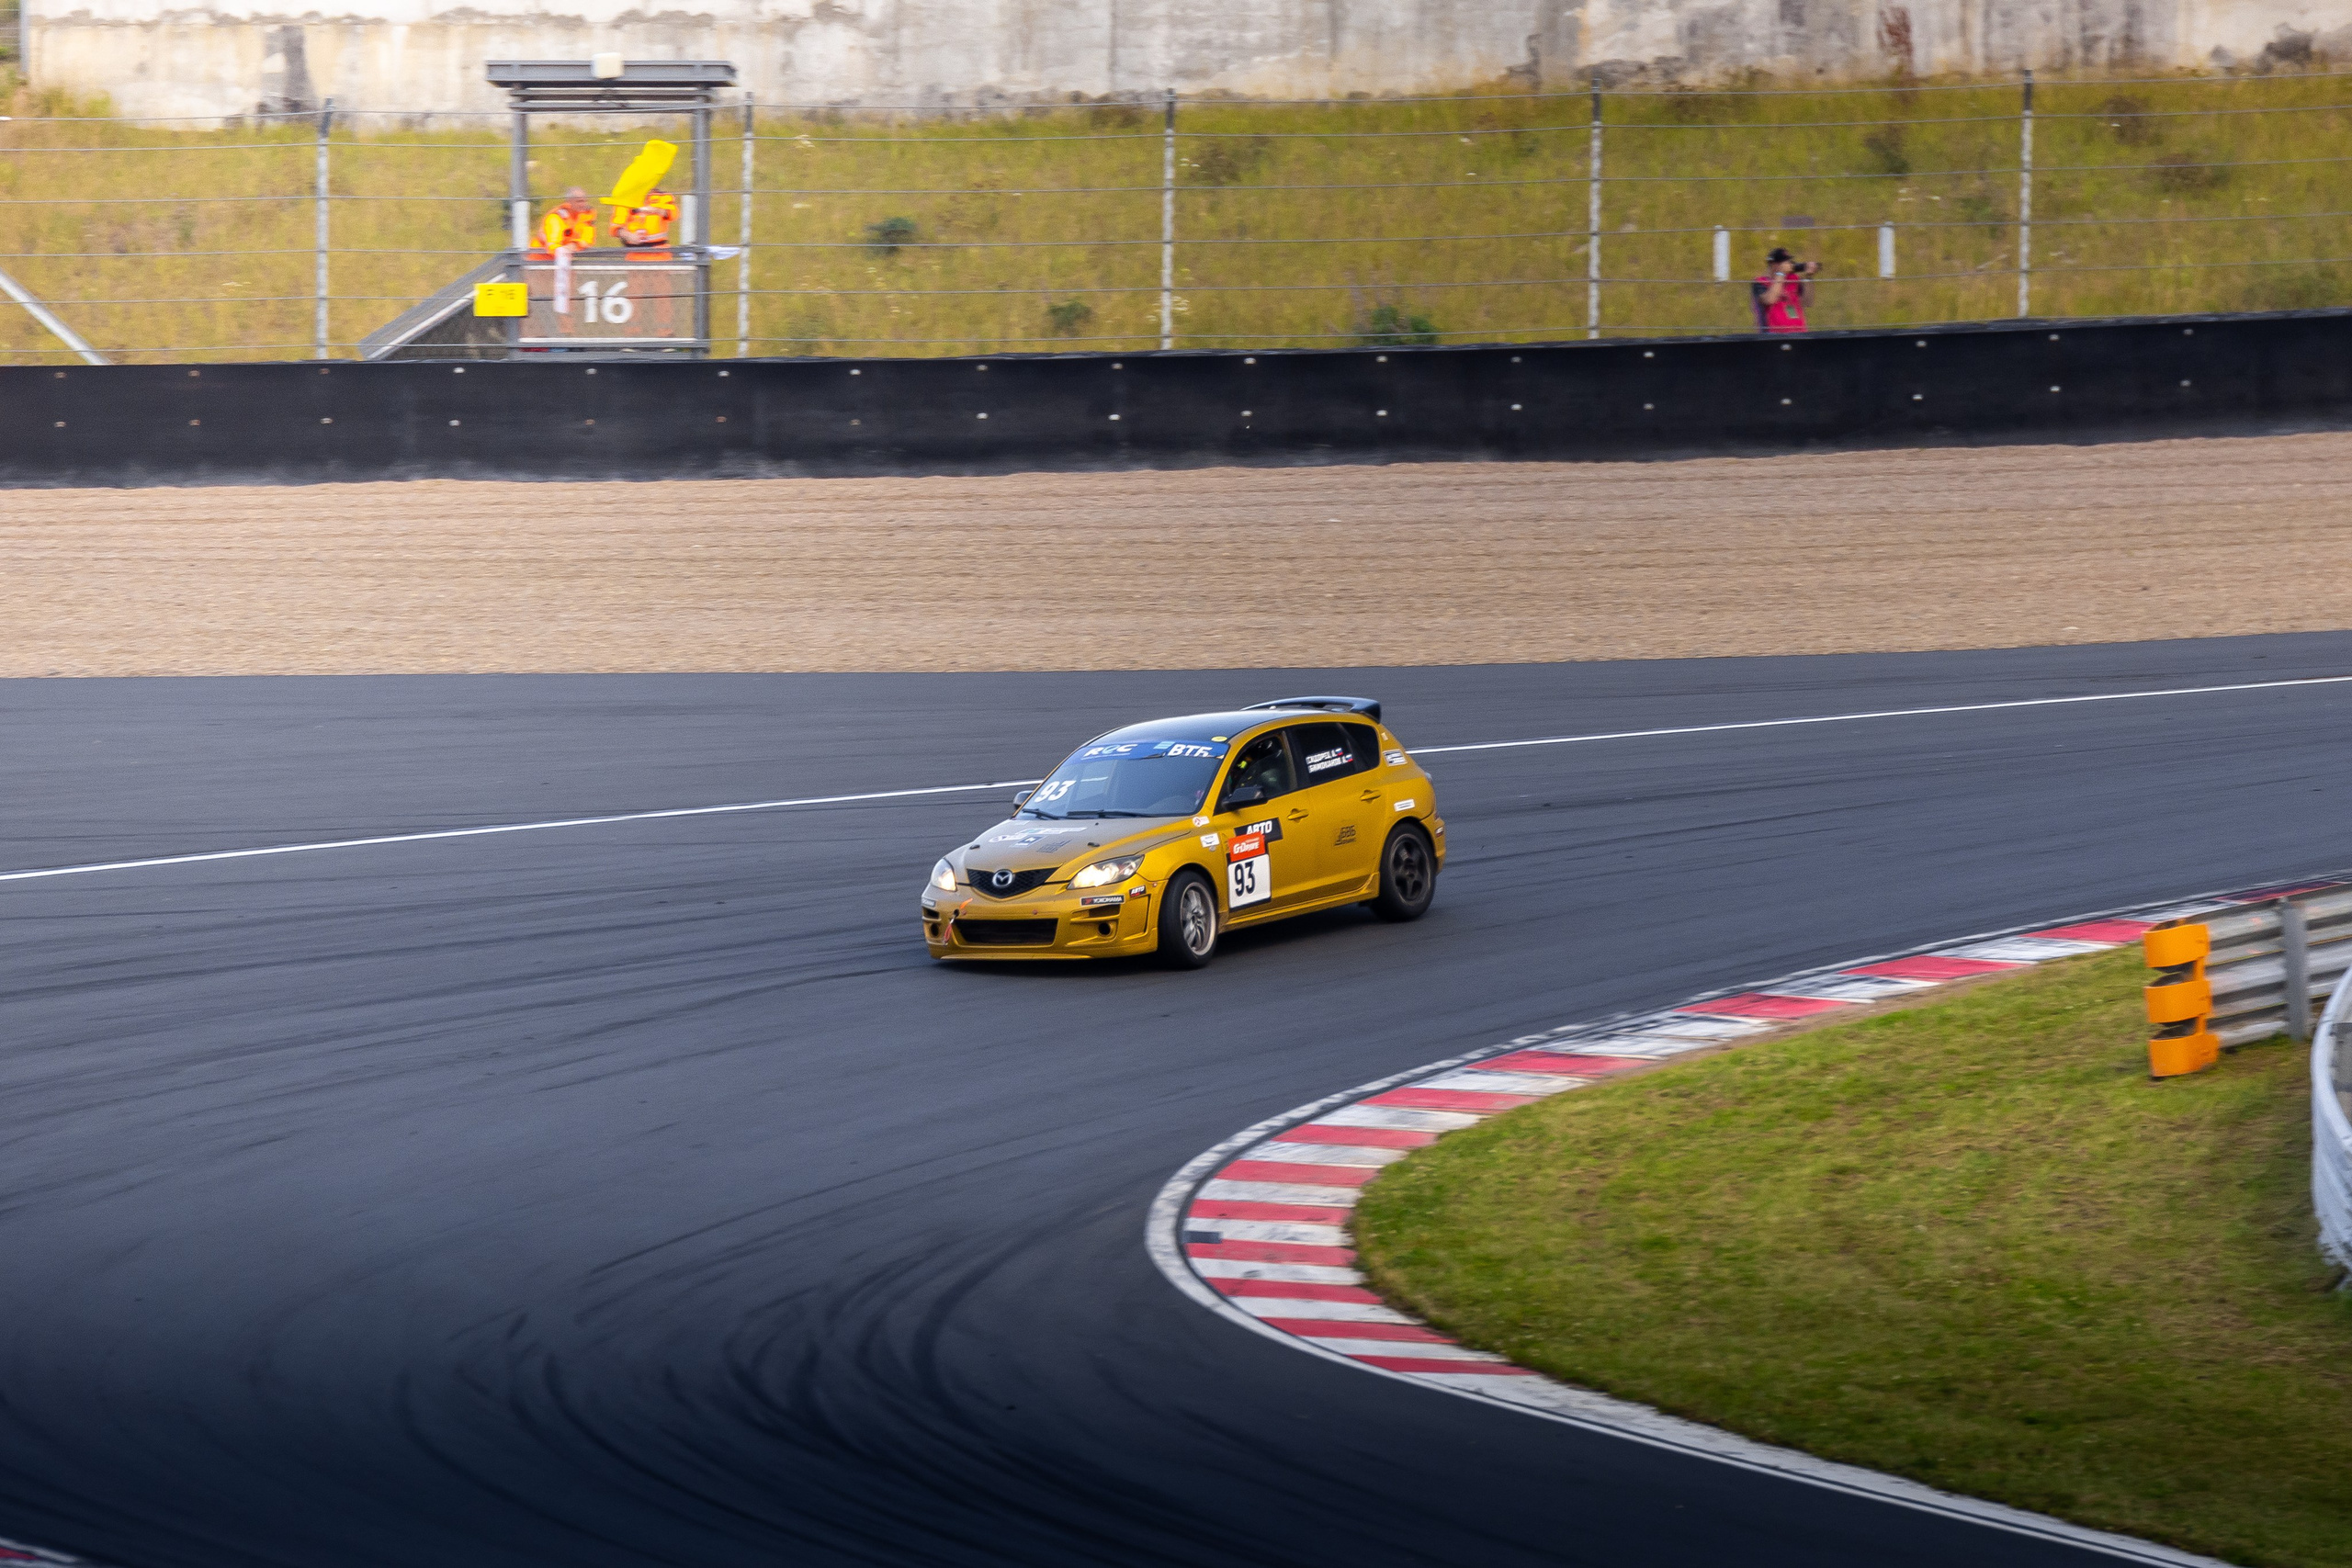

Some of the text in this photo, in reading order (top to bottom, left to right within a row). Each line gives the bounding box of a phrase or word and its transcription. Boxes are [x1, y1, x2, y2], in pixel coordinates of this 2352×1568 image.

[578, 281, 633, 323] 16
[1034, 780, 1077, 803] 93
[1234, 860, 1256, 897] 93
